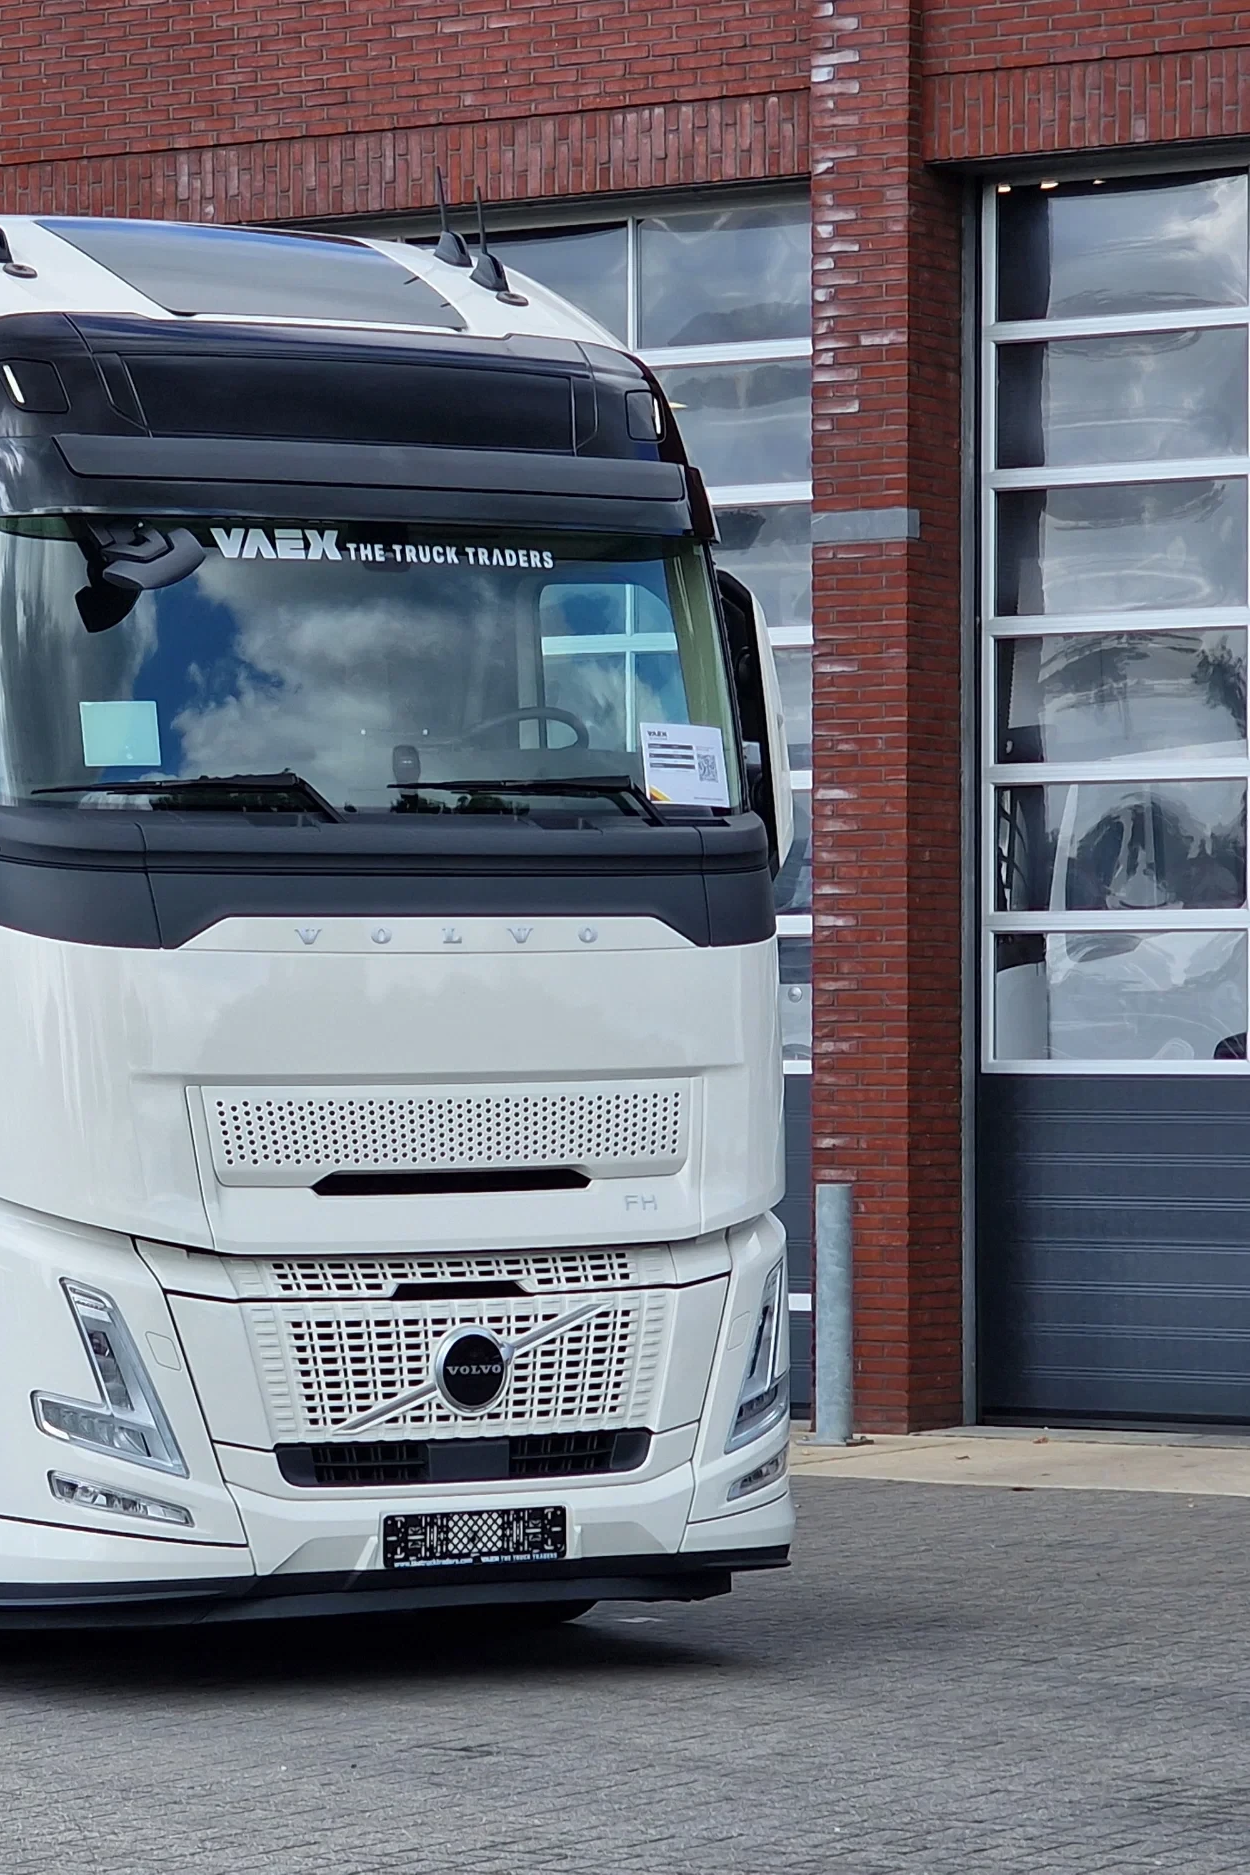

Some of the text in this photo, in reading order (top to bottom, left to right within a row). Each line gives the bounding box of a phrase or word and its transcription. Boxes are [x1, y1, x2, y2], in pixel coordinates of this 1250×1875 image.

[210, 527, 554, 569] VAEX THE TRUCK TRADERS
[294, 927, 599, 945] VOLVO
[624, 1194, 658, 1211] FH
[446, 1364, 502, 1375] VOLVO
